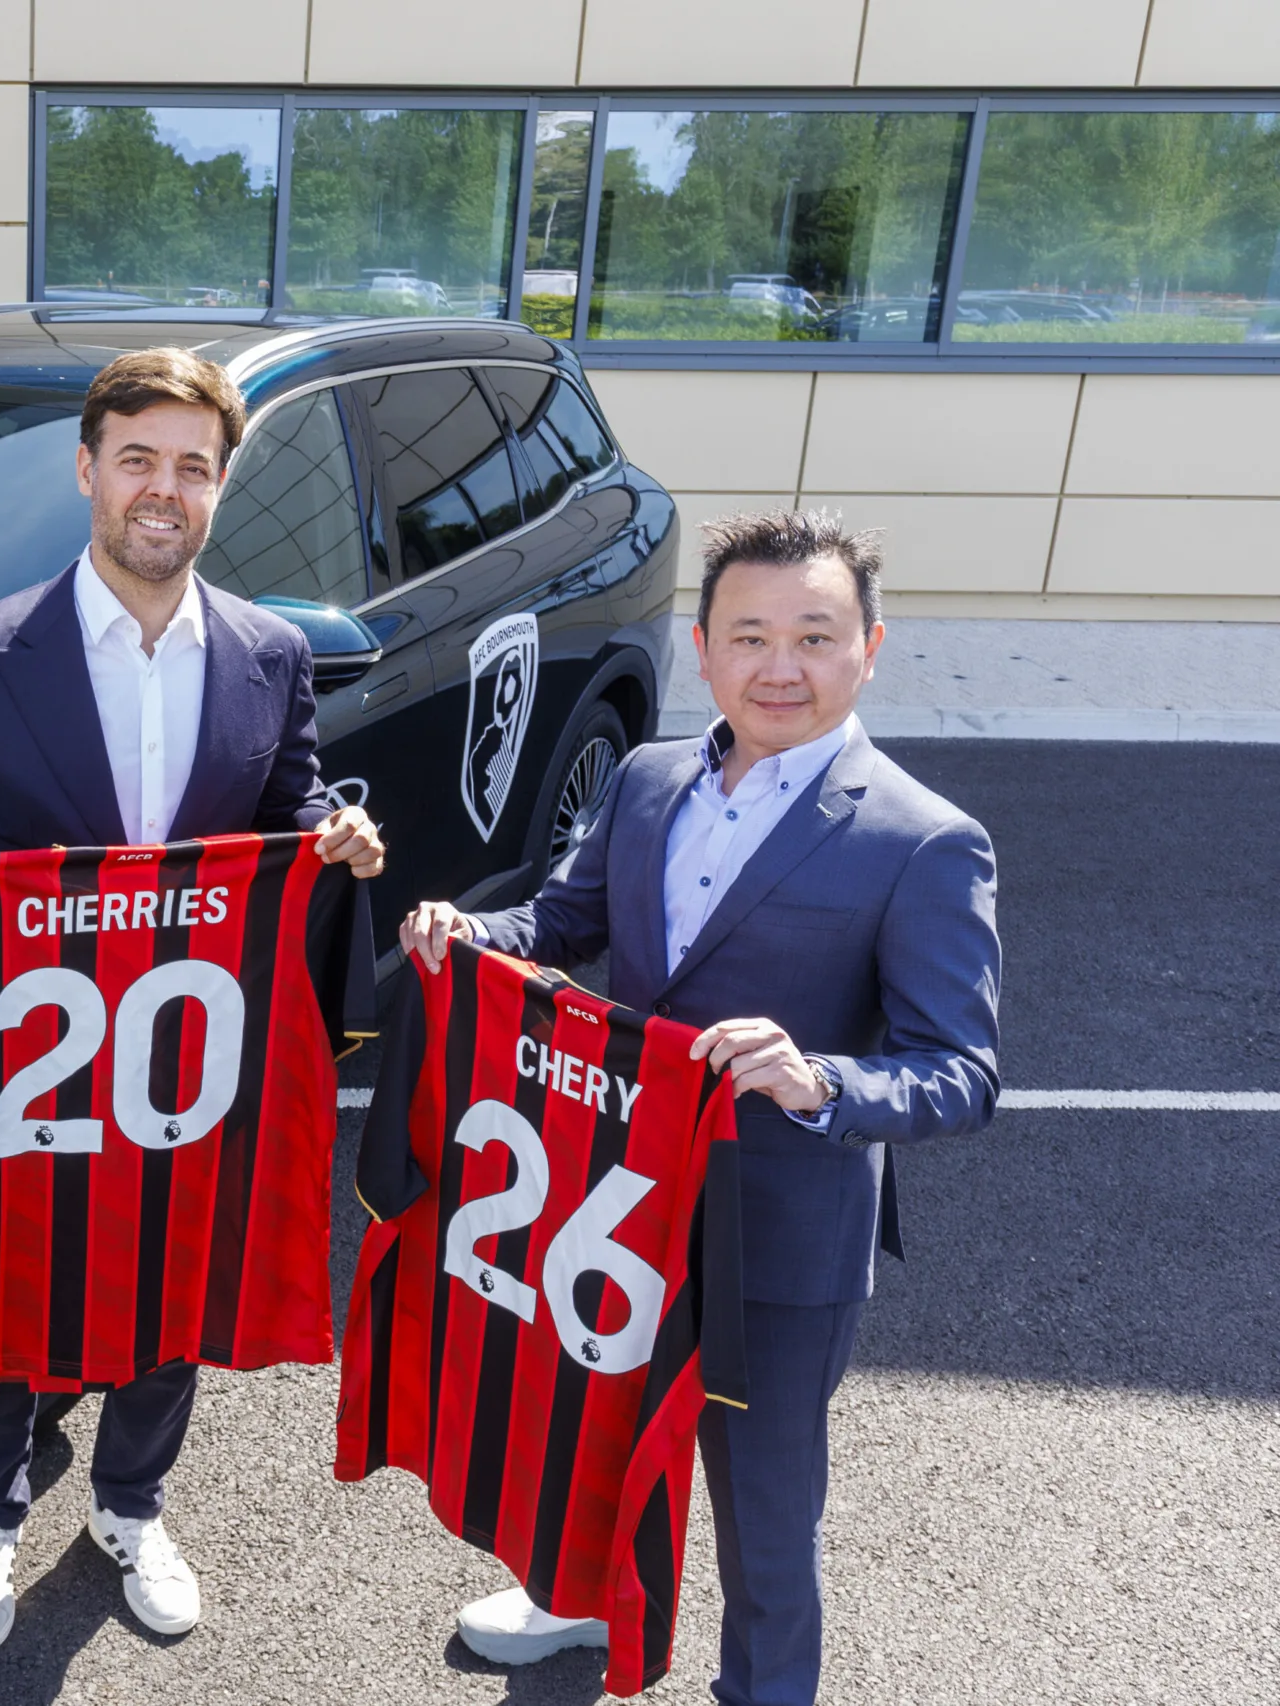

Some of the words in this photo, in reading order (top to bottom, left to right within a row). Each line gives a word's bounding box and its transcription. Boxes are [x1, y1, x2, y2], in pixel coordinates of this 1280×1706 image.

[474, 644, 486, 669] AFC
[486, 621, 535, 655] BOURNEMOUTH
[18, 886, 229, 938] CHERRIES
[566, 1004, 599, 1025] AFCB
[516, 1034, 643, 1124] CHERY
[443, 1098, 667, 1375] 26
